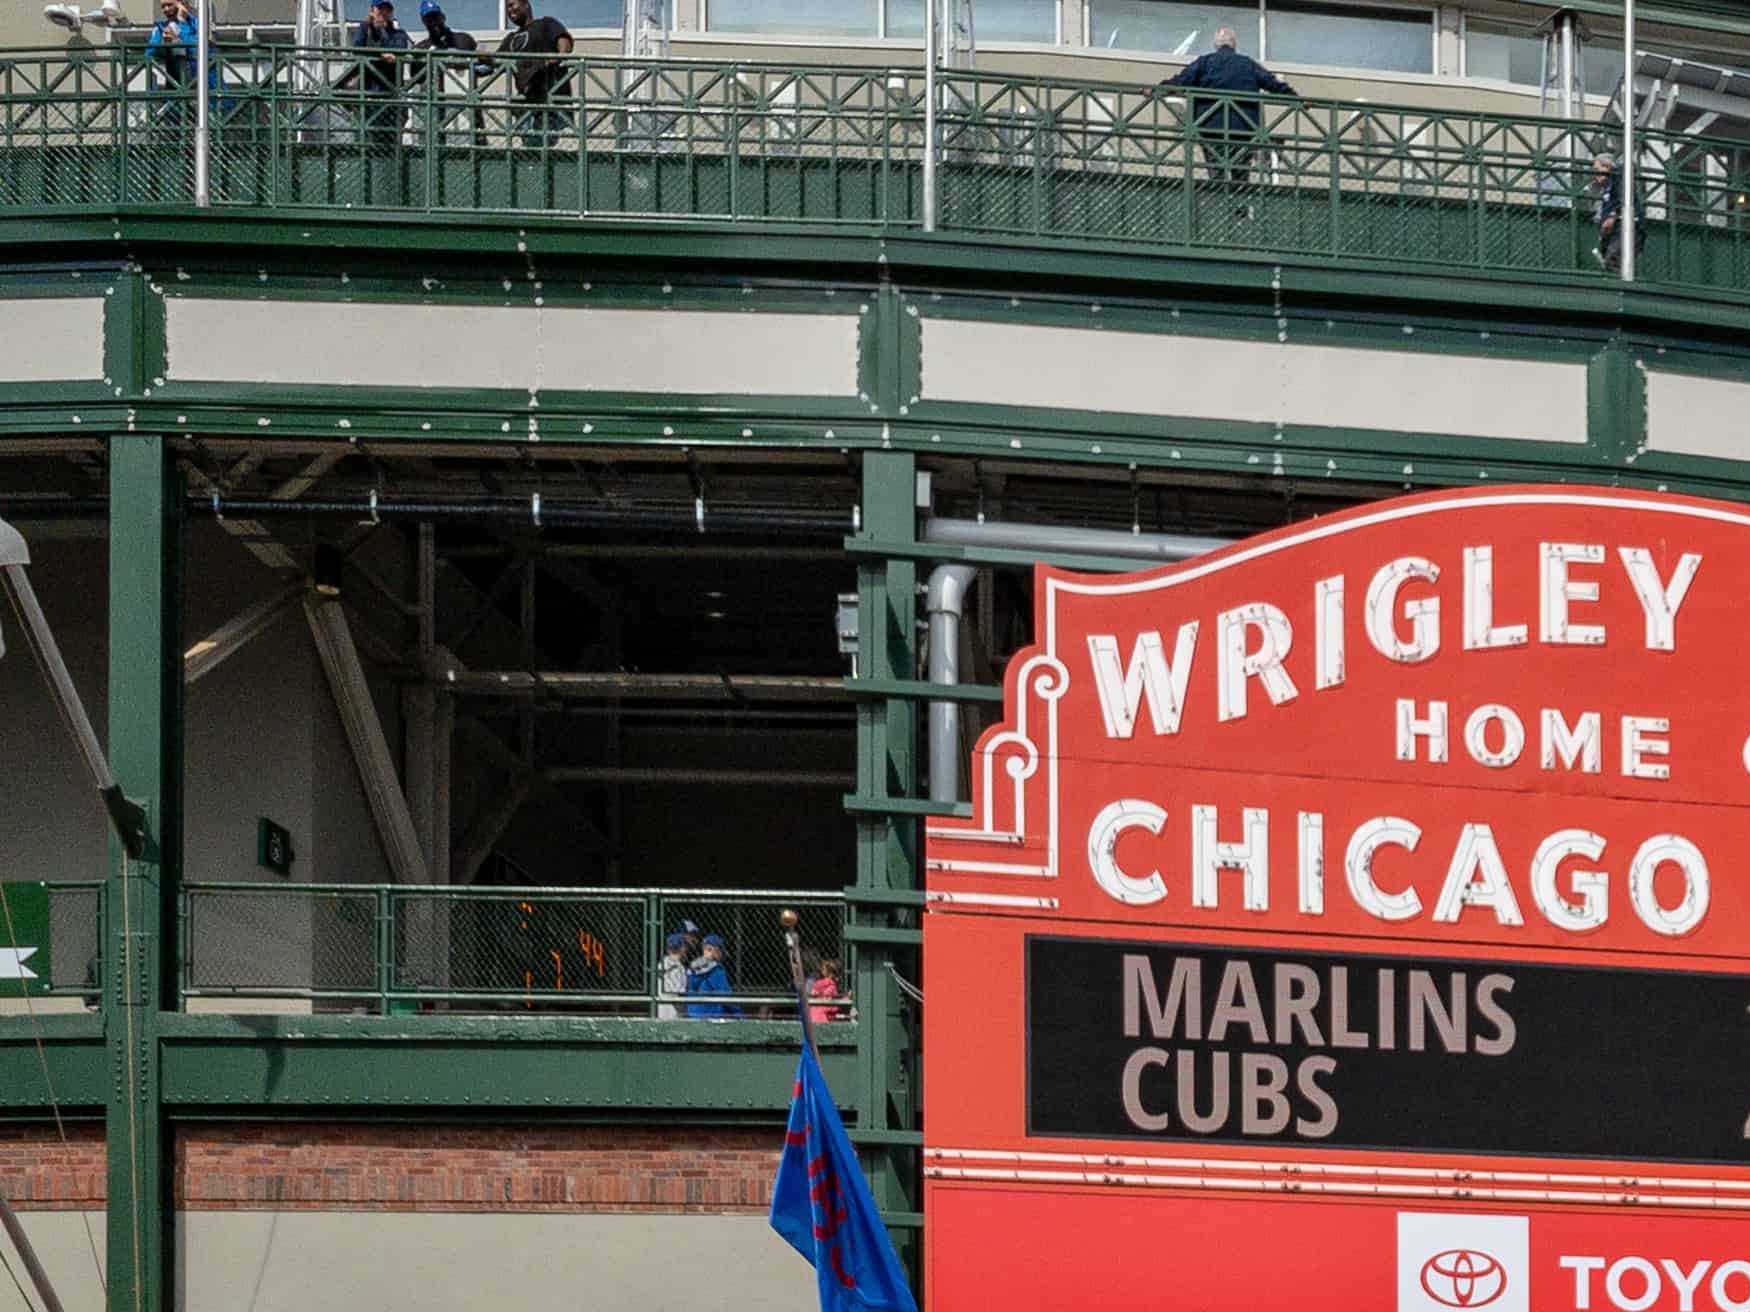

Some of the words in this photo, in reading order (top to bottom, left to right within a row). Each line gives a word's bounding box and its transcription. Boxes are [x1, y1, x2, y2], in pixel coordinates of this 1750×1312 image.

[1085, 540, 1704, 739] WRIGLEY
[1394, 697, 1671, 780] HOME
[1086, 798, 1711, 937] CHICAGO
[1121, 952, 1518, 1057] MARLINS
[1121, 1046, 1340, 1139] CUBS
